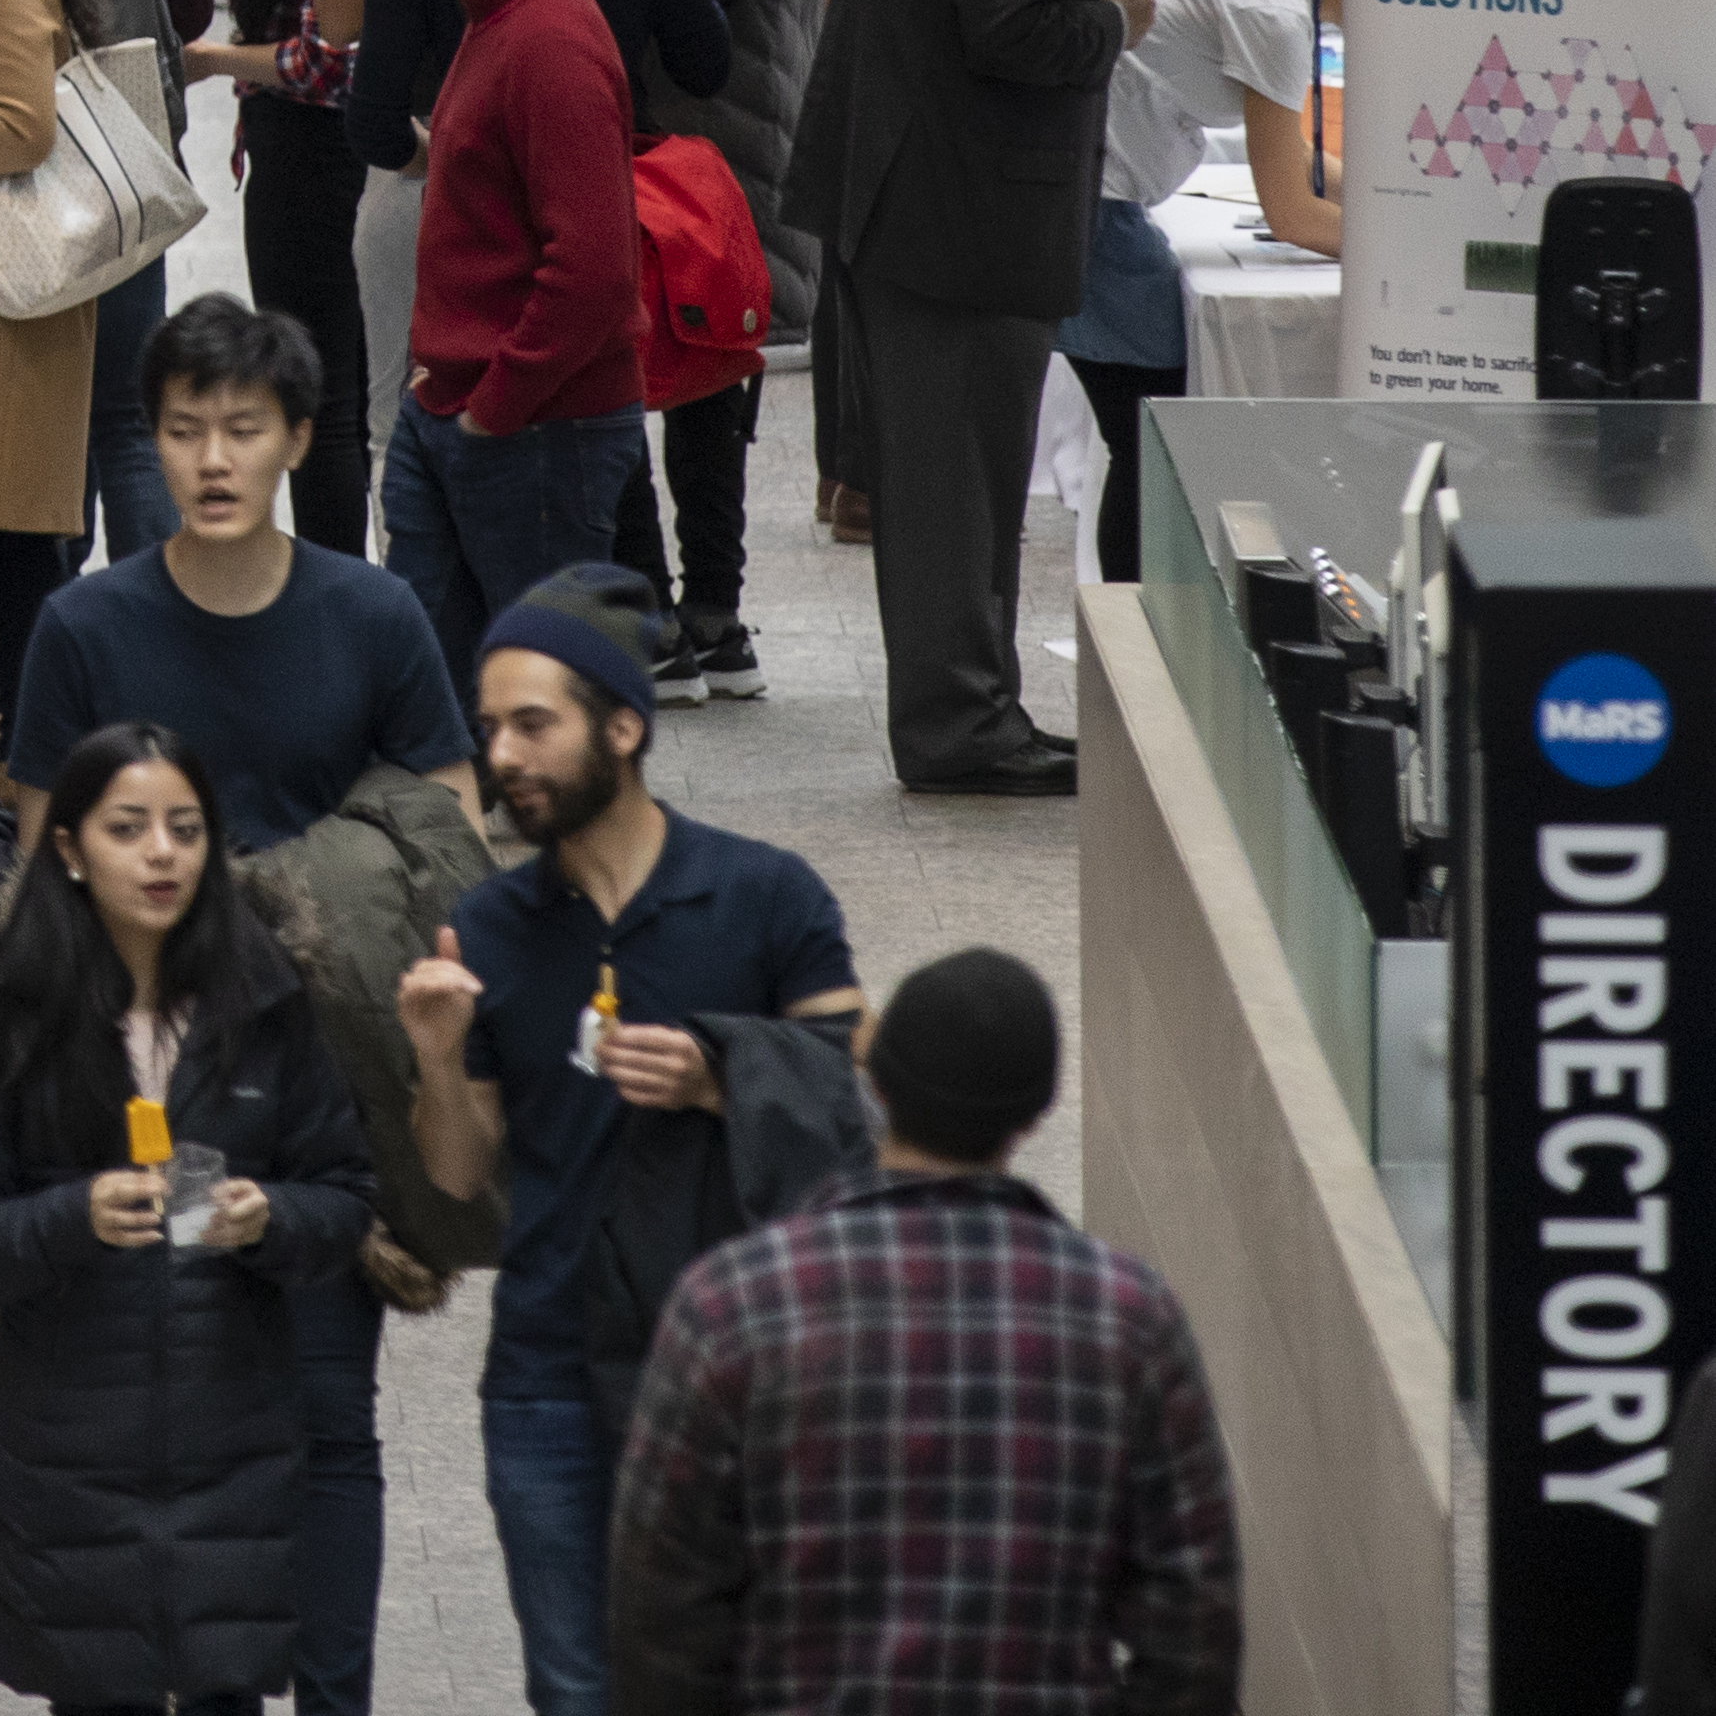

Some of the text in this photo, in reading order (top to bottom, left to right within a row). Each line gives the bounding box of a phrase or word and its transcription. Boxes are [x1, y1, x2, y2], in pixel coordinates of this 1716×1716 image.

[1370, 344, 1537, 374] You don't have to sacrific
[1370, 371, 1504, 394] to green your home.
[1542, 699, 1665, 744] MaRS
[1538, 824, 1669, 1527] DIRECTORY
